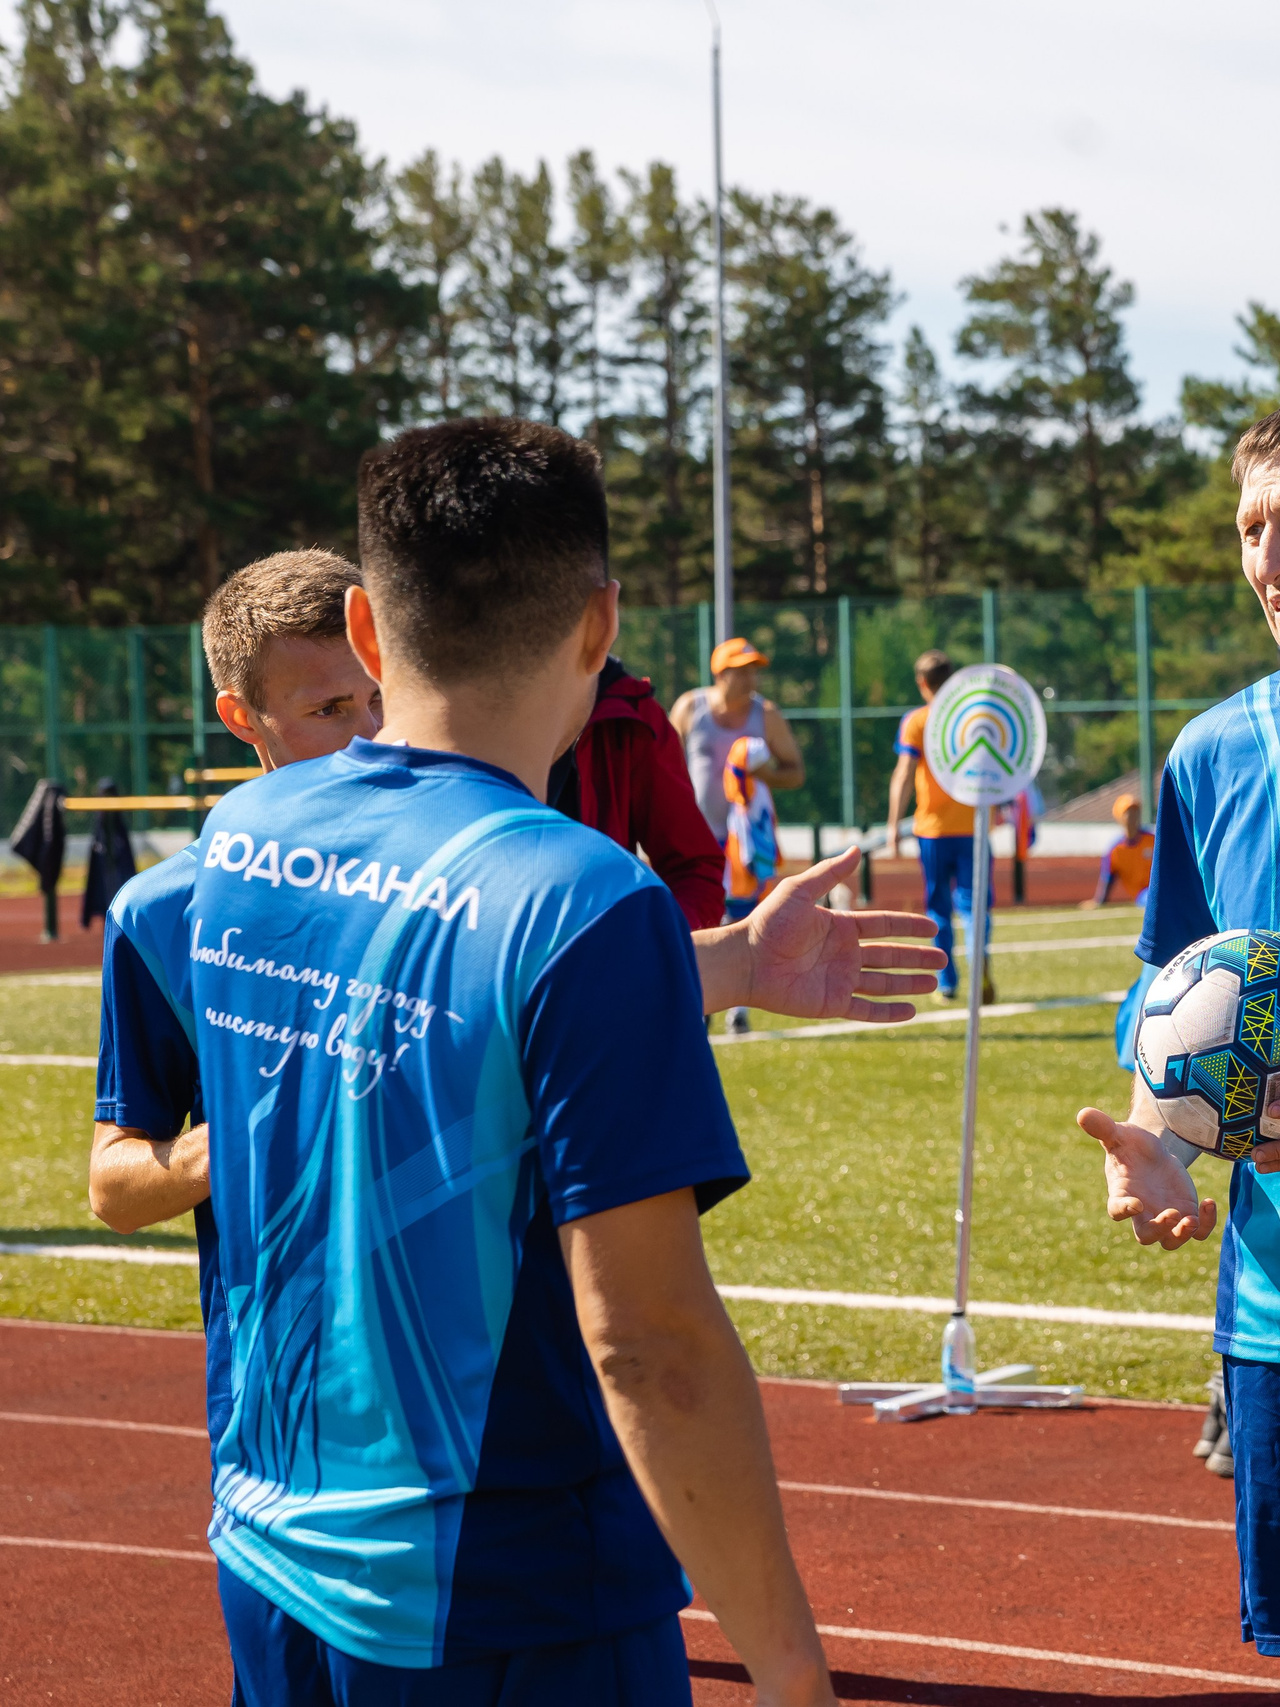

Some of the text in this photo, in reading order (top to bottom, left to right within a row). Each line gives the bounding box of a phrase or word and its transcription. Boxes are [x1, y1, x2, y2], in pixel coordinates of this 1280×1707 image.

[204, 831, 480, 930] ВОДОКАНАЛ
[205, 1007, 410, 1101] чистую воду!
[346, 978, 436, 1039] городу
